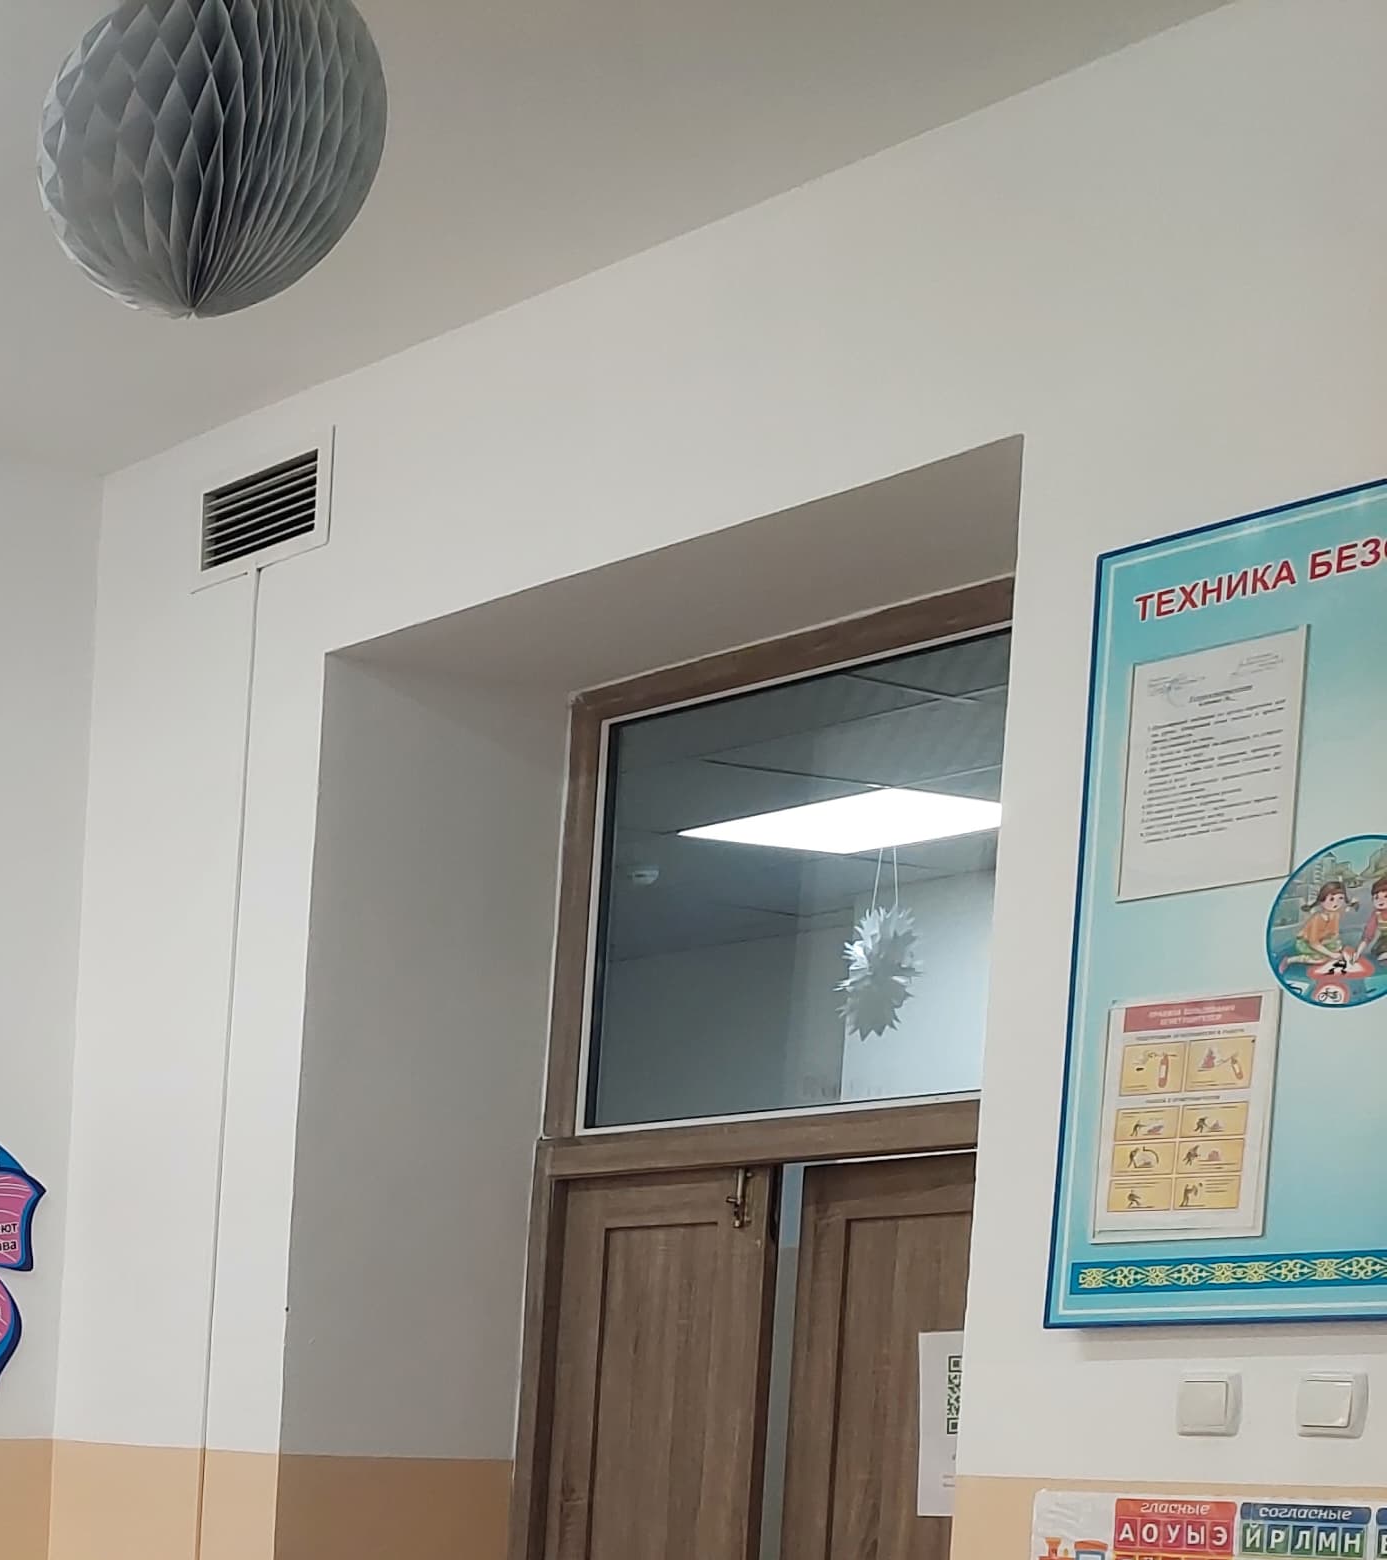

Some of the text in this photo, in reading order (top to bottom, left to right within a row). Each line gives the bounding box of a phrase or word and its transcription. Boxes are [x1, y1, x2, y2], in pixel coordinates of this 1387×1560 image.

[1135, 538, 1387, 622] ТЕХНИКА БЕЗ
[1141, 1501, 1210, 1516] гласные
[1259, 1505, 1352, 1521] согласные
